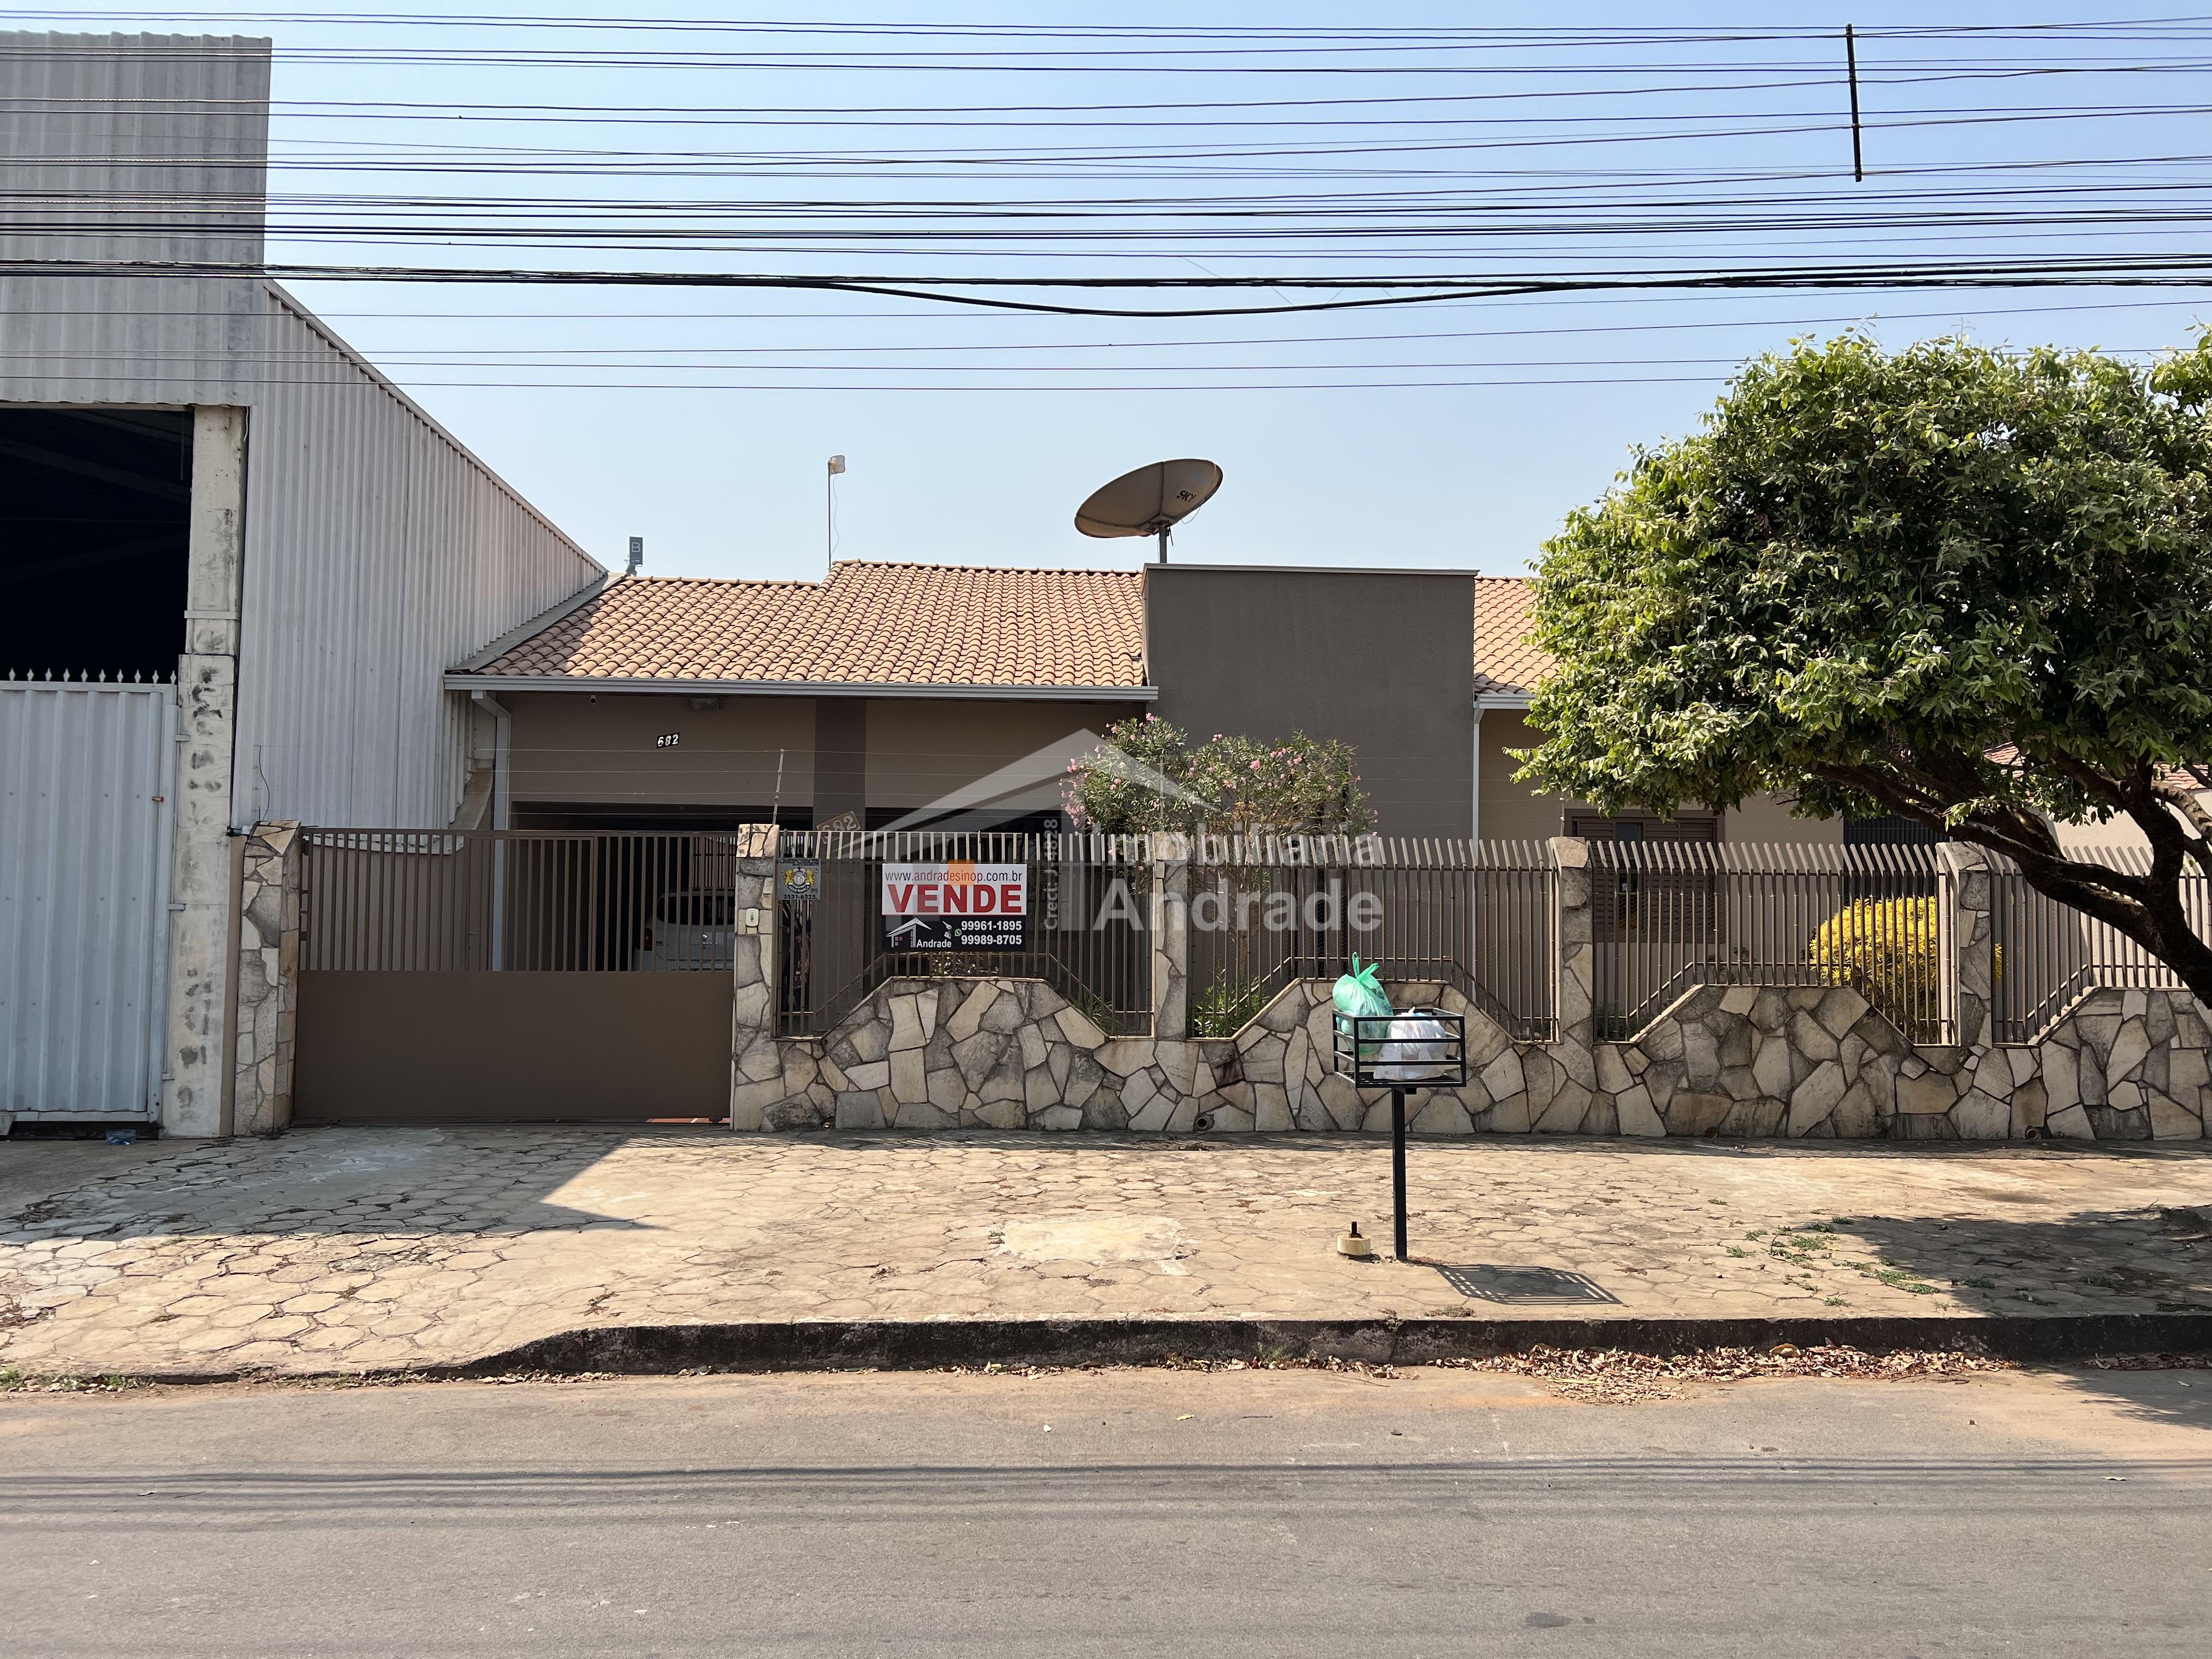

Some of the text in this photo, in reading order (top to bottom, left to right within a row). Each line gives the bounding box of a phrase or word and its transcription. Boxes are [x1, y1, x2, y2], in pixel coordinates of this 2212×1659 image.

[657, 733, 679, 747] 682
[885, 870, 1022, 883] www.andradesinop.com.br
[887, 884, 1022, 913] VENDE
[961, 920, 1022, 931] 99961-1895
[916, 939, 952, 948] Andrade
[961, 934, 1022, 945] 99989-8705
